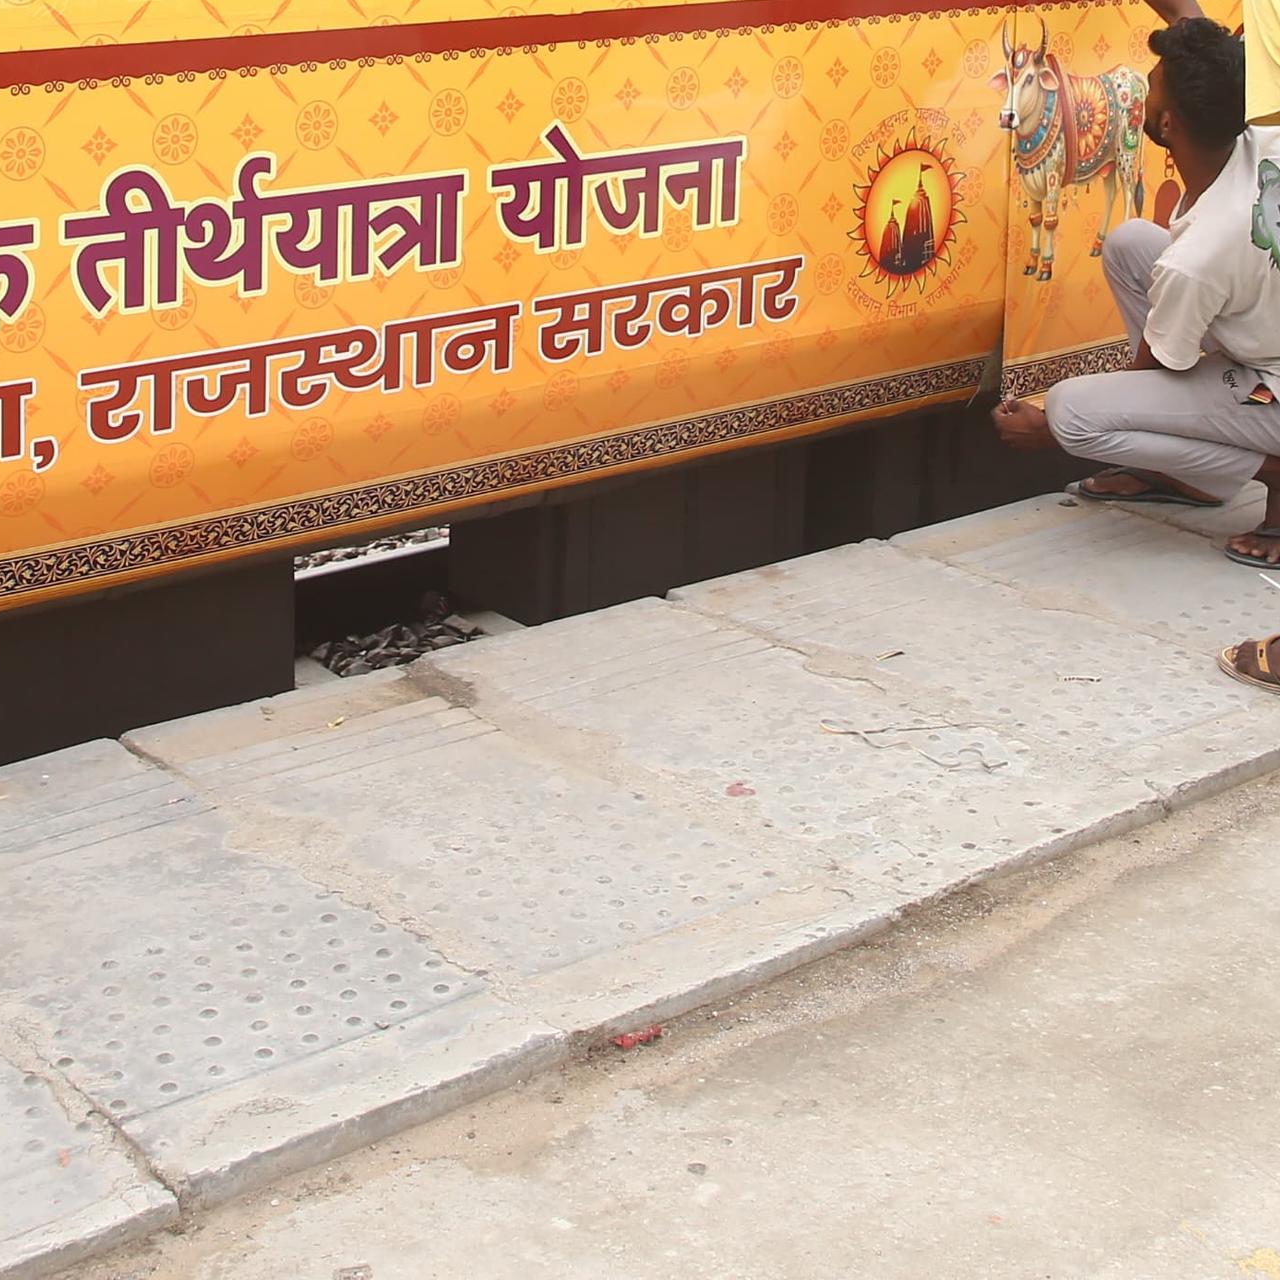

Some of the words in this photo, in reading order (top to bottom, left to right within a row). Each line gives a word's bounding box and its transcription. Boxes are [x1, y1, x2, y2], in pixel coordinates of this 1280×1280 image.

[63, 155, 466, 312] तीर्थयात्रा
[491, 125, 743, 250] योजना
[887, 300, 917, 318] विभाग
[82, 302, 515, 443] राजस्थान
[535, 256, 803, 362] सरकार
